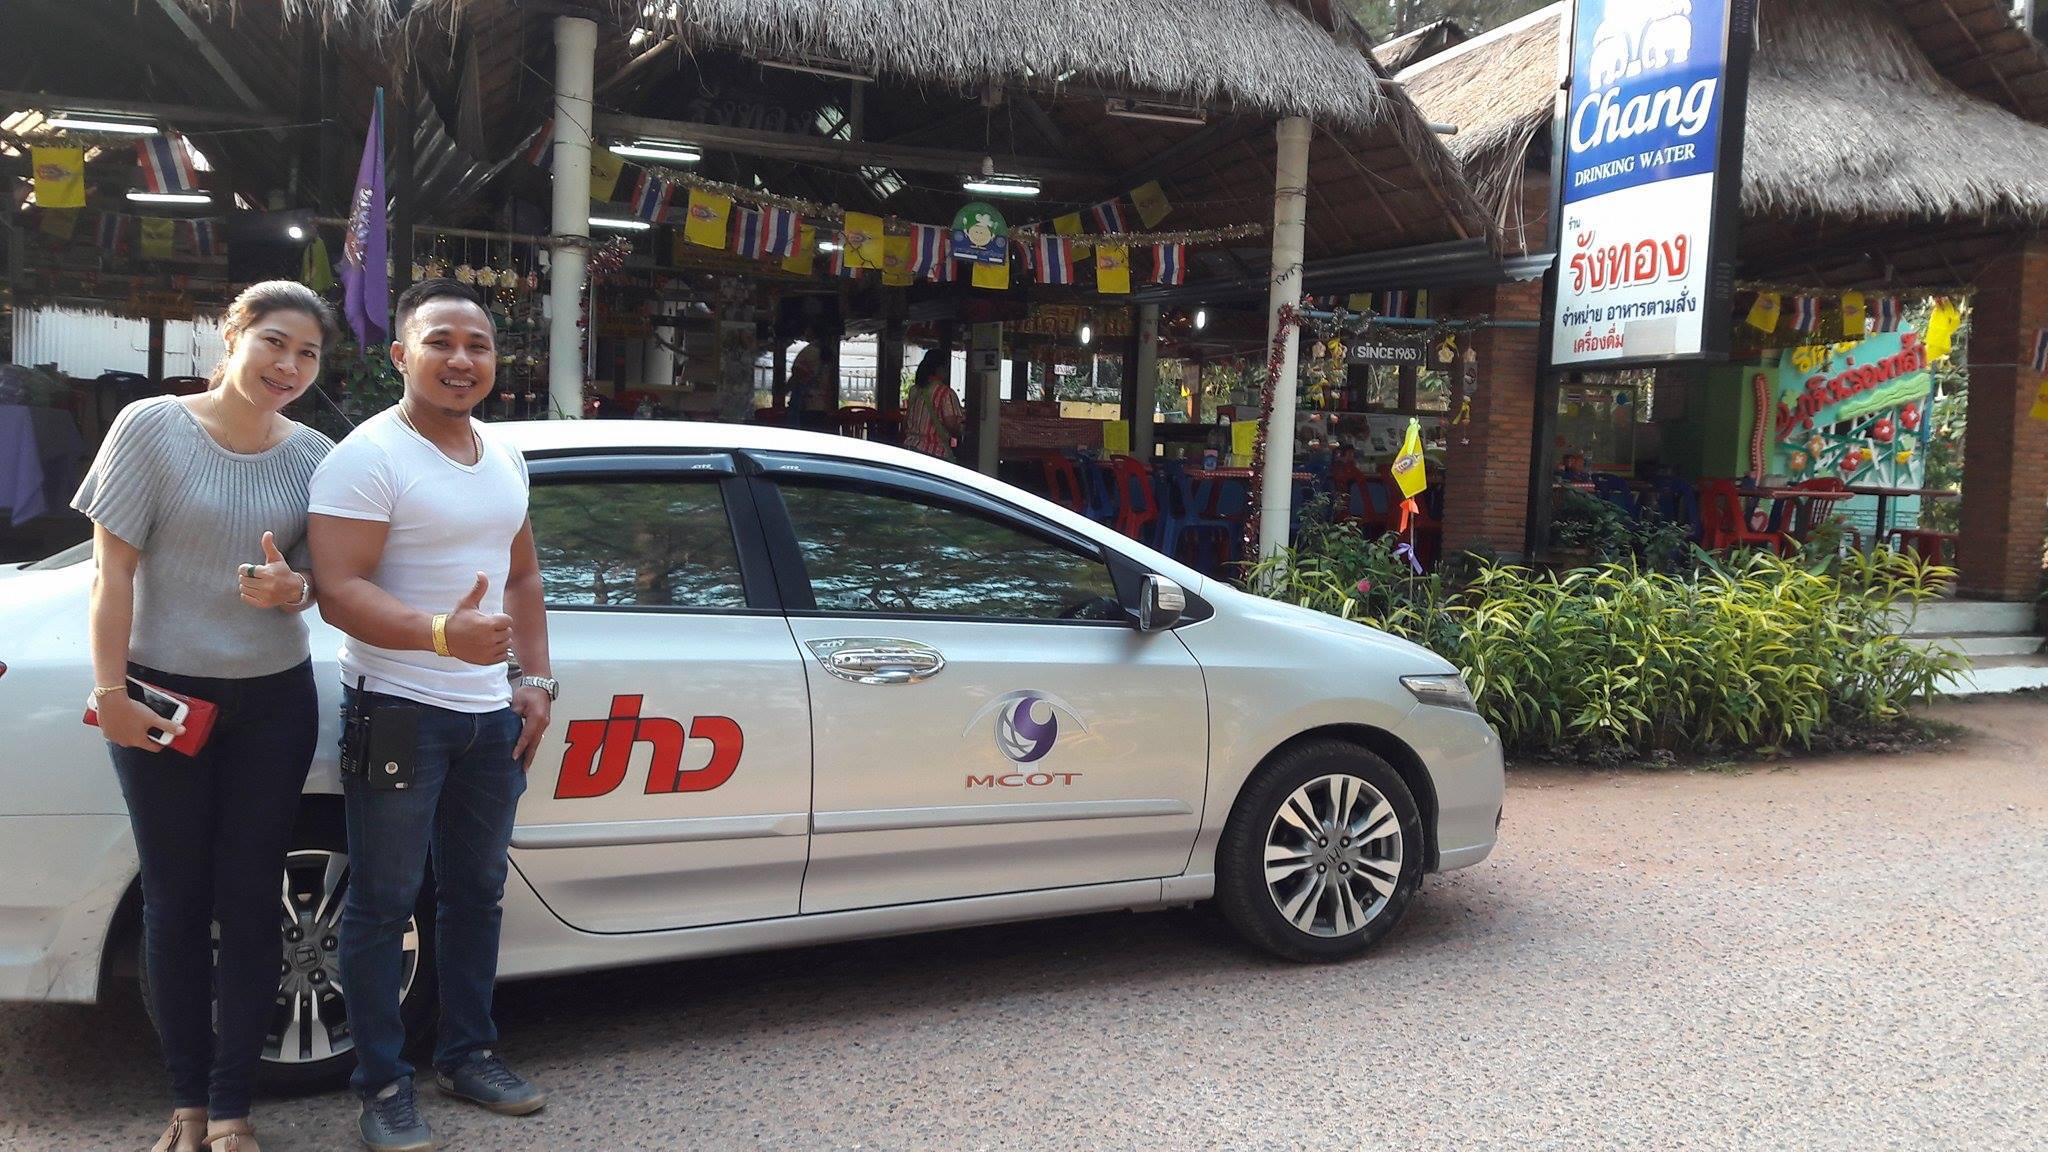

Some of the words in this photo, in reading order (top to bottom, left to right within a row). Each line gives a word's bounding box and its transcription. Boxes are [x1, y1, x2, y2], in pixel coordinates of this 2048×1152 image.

[1570, 77, 1718, 154] Chang
[1574, 156, 1636, 188] DRINKING
[1639, 143, 1697, 169] WATER
[1568, 216, 1581, 230] ร้าน
[1570, 230, 1690, 294] รังทอง
[1562, 303, 1603, 328] จำหน่าย
[1606, 285, 1697, 321] อาหารตามสั่ง
[1573, 322, 1625, 354] เครื่องดื่ม
[554, 693, 744, 800] ข่าว
[964, 773, 1083, 789] MCOT
